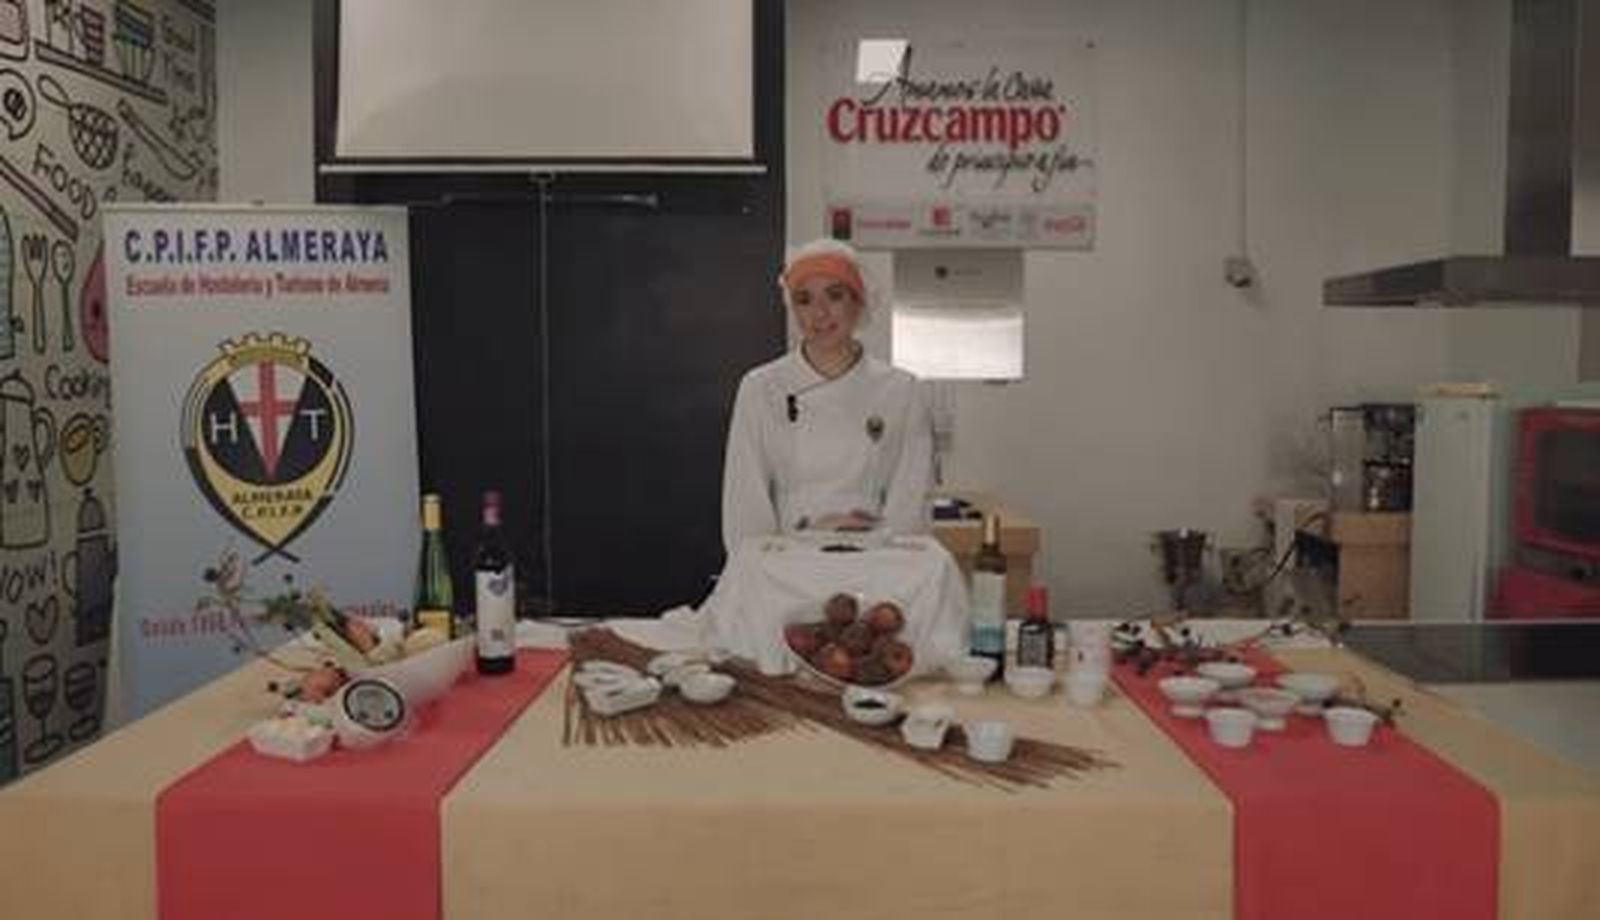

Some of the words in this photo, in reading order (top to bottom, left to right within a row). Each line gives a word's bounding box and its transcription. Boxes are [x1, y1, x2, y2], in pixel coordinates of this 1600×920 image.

[827, 96, 1061, 150] Cruzcampo
[124, 229, 237, 264] C.P.I.F.P.
[246, 229, 389, 264] ALMERAYA
[125, 273, 177, 297] Escuela
[181, 272, 195, 295] de
[265, 278, 273, 300] y
[275, 271, 324, 294] Turismo
[328, 271, 342, 293] de
[210, 410, 239, 444] H
[299, 408, 326, 442] T
[231, 486, 313, 505] ALMERAYA
